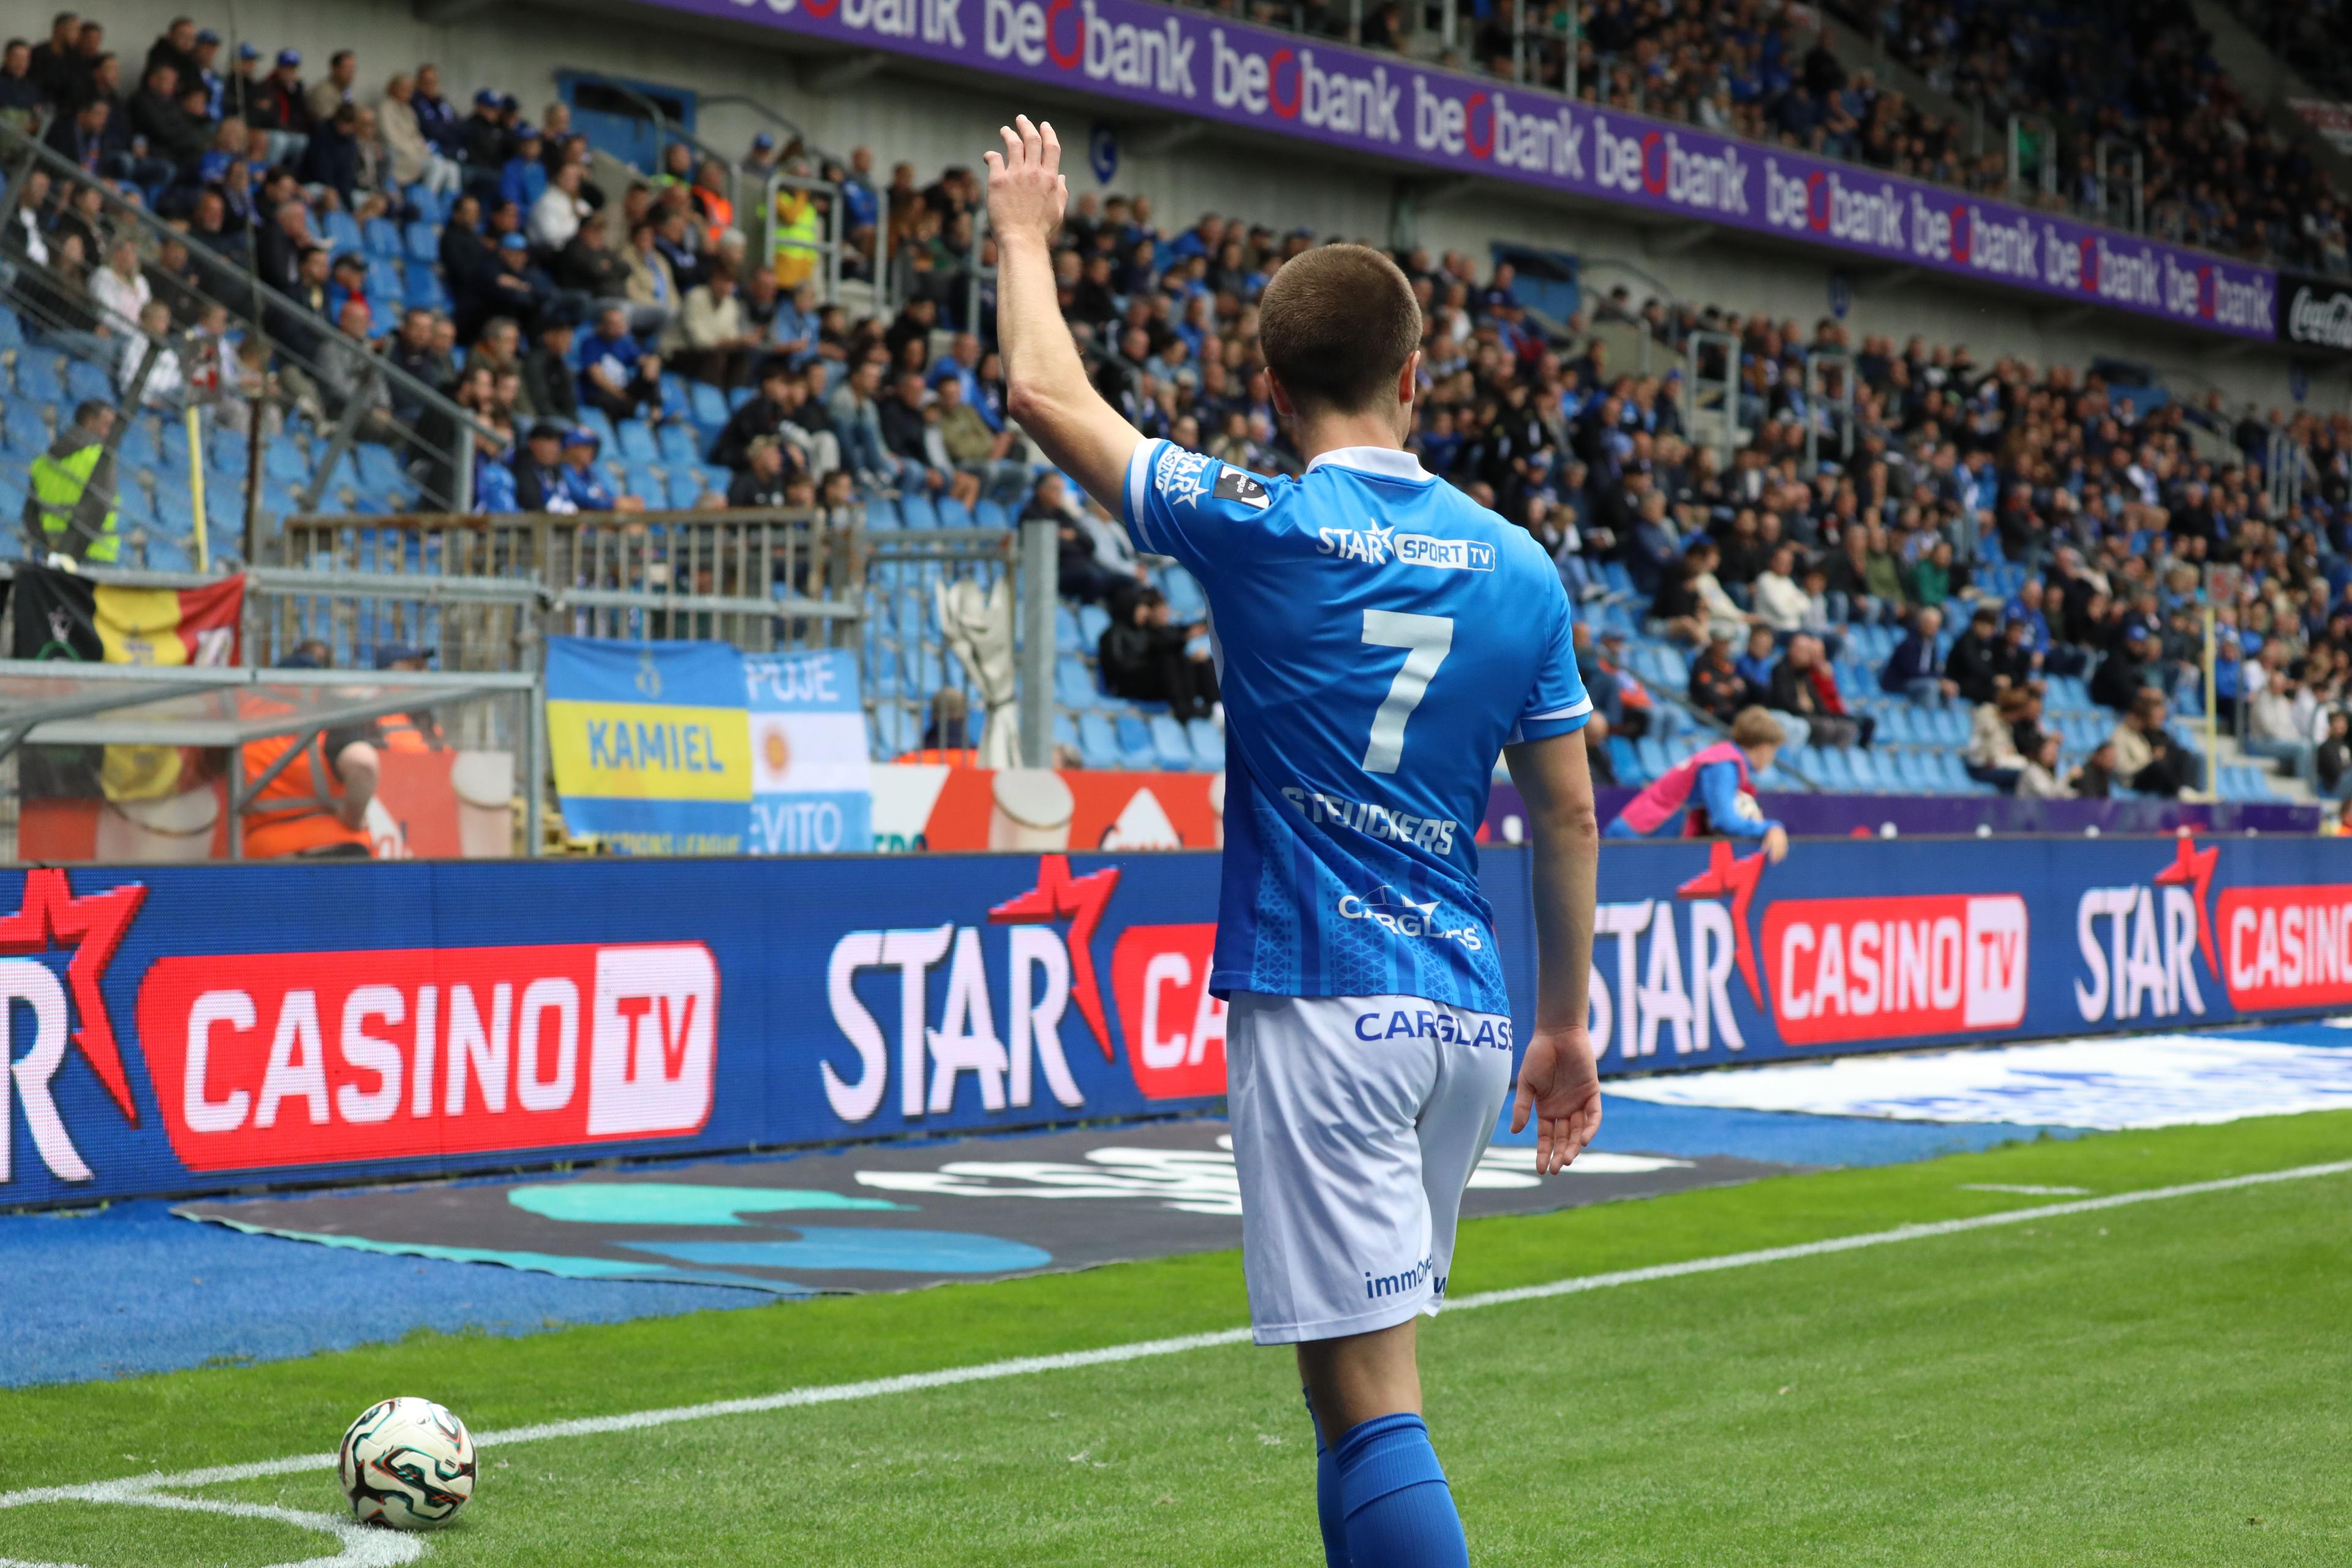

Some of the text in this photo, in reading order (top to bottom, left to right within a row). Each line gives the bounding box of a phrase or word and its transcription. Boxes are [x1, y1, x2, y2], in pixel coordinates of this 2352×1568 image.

[1316, 526, 1490, 565] STAR SPORT TV
[1361, 609, 1453, 774] 7
[586, 718, 724, 773] KAMIEL
[749, 796, 843, 853] VITO
[1281, 787, 1457, 856] STEUCKERS
[1781, 916, 1961, 1021] CASINO
[1978, 930, 2016, 992] TV
[2074, 883, 2206, 1022] STAR
[182, 977, 580, 1133] CASINO
[616, 995, 696, 1082] TV
[820, 921, 1085, 1121] STAR
